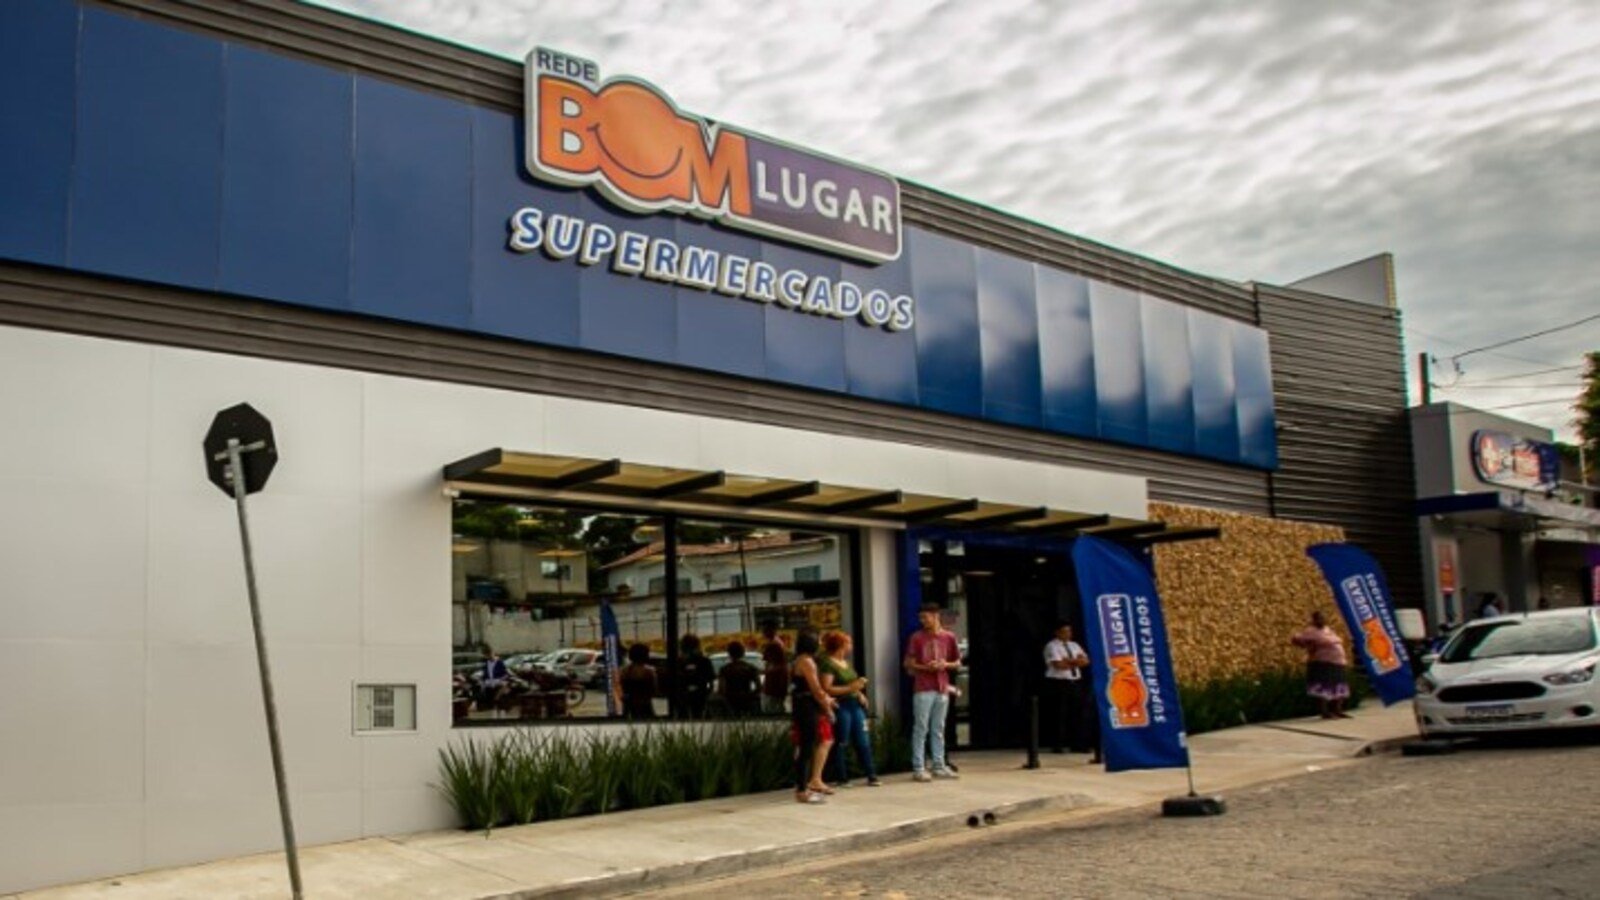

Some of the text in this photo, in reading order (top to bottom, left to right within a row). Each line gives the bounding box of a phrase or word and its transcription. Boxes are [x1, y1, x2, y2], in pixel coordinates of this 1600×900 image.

[537, 50, 596, 81] REDE
[538, 75, 893, 234] BOM LUGAR
[511, 207, 914, 330] SUPERMERCADOS
[1107, 597, 1130, 654] LUGAR
[1135, 596, 1166, 722] SUPERMERCADOS
